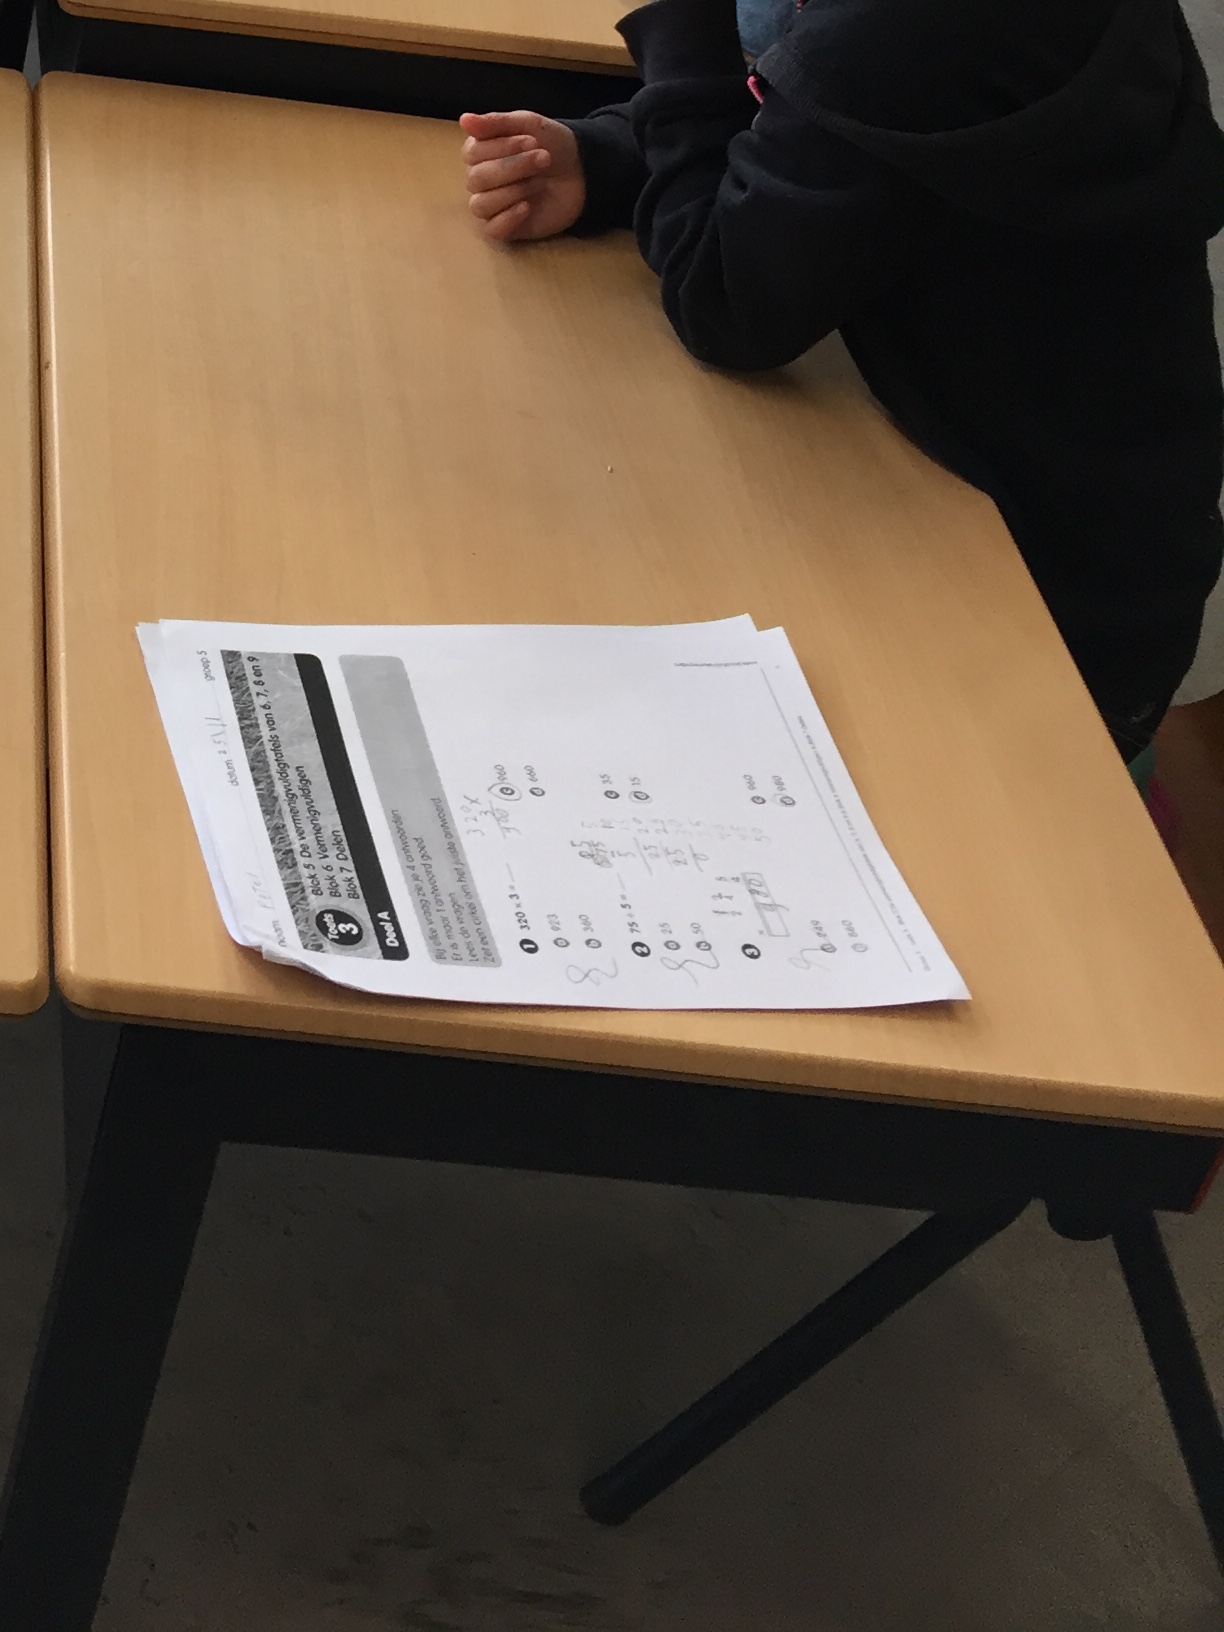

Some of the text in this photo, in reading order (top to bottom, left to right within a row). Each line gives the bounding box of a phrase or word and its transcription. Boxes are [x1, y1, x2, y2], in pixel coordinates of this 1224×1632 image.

[200, 657, 216, 681] groep
[251, 665, 263, 678] en
[252, 679, 265, 687] 8
[264, 713, 276, 732] van
[225, 759, 239, 787] datum
[494, 764, 508, 781] 960
[523, 765, 538, 782] 660
[599, 773, 613, 785] 35
[629, 776, 641, 786] 15
[743, 774, 758, 790] 960
[268, 734, 306, 841] vermenigvuldigtafels
[295, 765, 342, 898] Blok 6 Vermenigvuldigen
[300, 843, 312, 858] De
[331, 829, 349, 862] Delen
[421, 862, 445, 907] antwoord
[454, 867, 467, 883] het
[307, 873, 324, 897] Blok
[342, 876, 360, 900] Blok
[461, 884, 474, 900] om
[419, 898, 435, 925] vraag
[515, 911, 530, 930] 320
[322, 913, 339, 940] Toets
[338, 923, 359, 935] 3
[377, 911, 399, 947] Deel A
[440, 915, 453, 940] maar
[547, 913, 562, 932] 923
[578, 914, 594, 932] 360
[627, 921, 641, 933] 75
[659, 922, 673, 935] 25
[690, 922, 704, 934] 50
[475, 927, 489, 946] een
[464, 940, 479, 962] Lees
[481, 947, 495, 963] Zet
